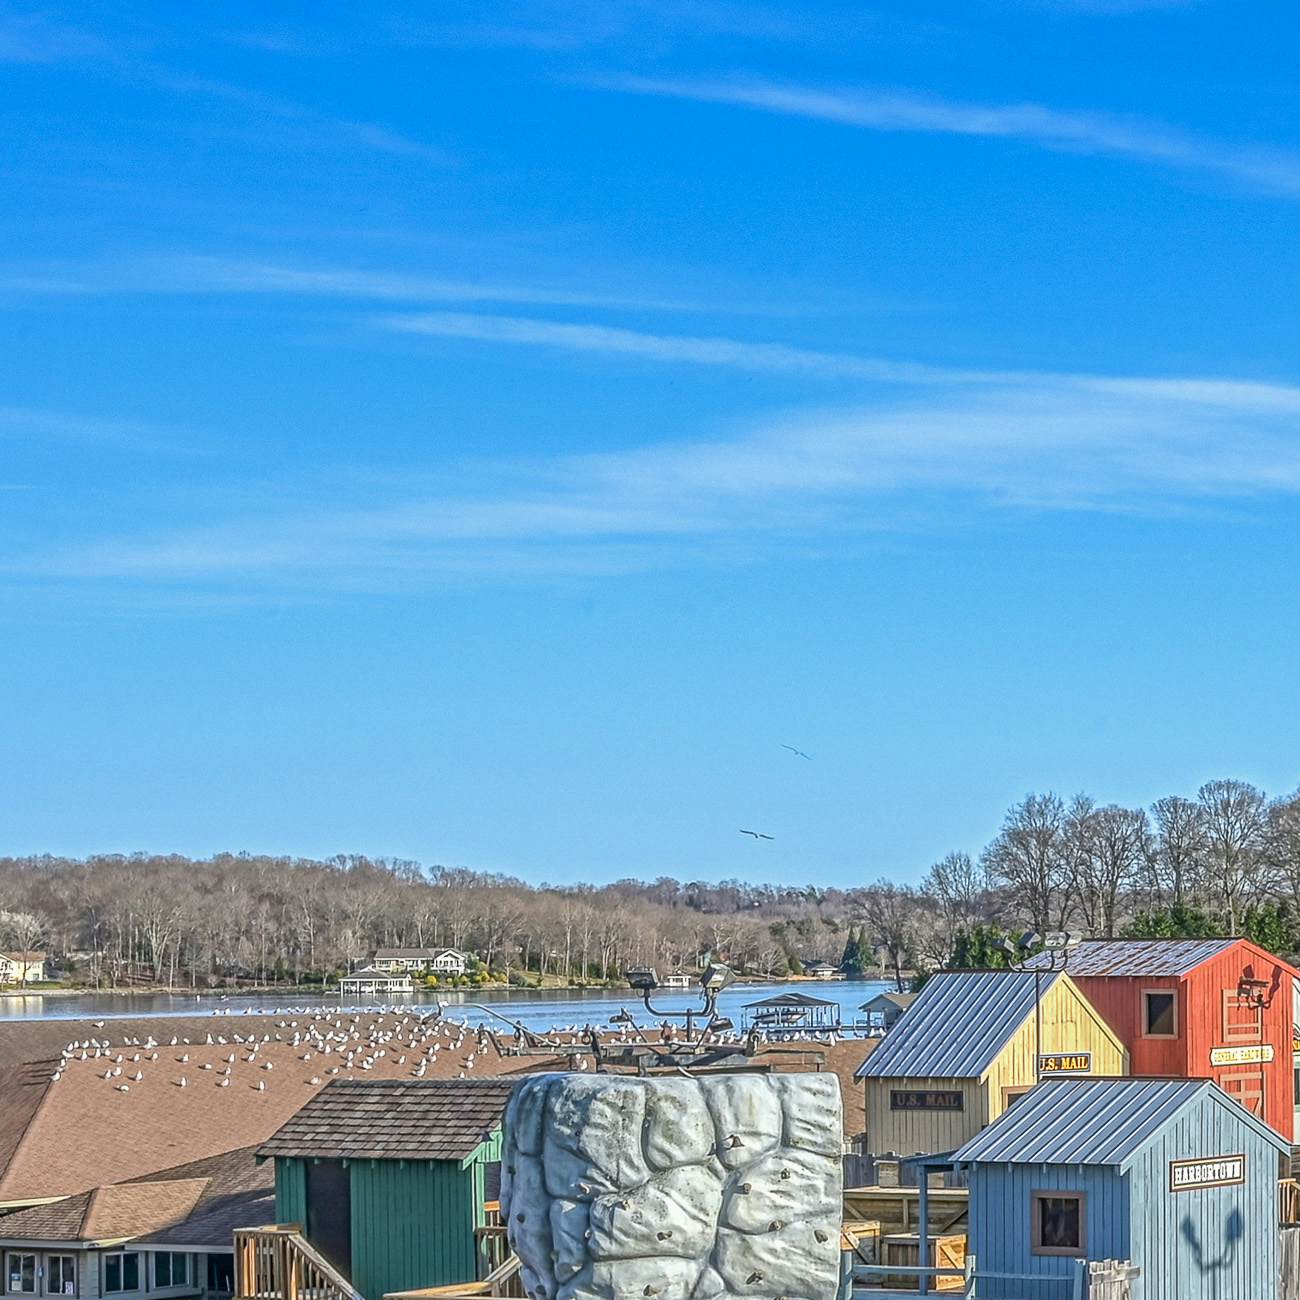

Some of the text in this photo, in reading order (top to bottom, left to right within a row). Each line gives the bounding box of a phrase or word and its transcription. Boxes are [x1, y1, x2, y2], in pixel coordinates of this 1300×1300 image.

[1061, 1056, 1088, 1070] MAIL
[896, 1094, 958, 1107] U.S. MAIL
[1174, 1160, 1241, 1185] HARBORTOWN
